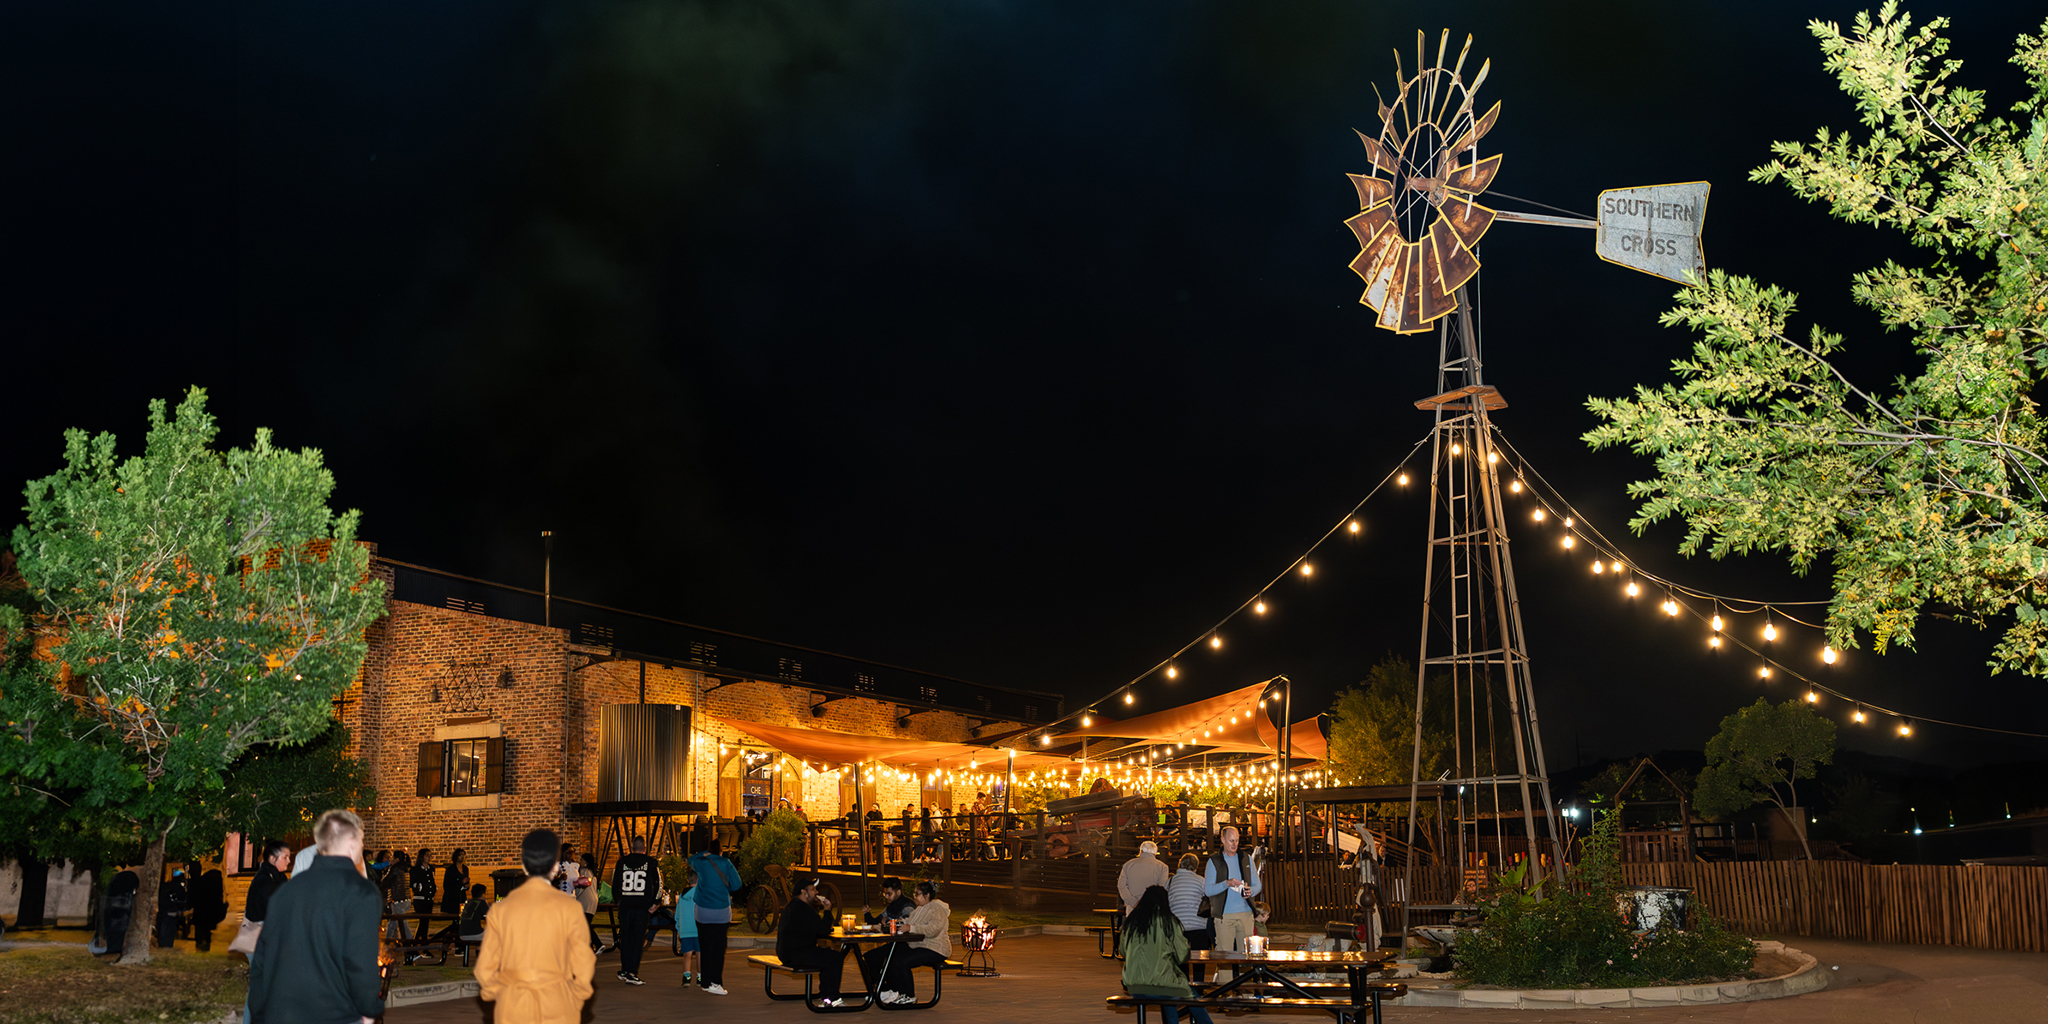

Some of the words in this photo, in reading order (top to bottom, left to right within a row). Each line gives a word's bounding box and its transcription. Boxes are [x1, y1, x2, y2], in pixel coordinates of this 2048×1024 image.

[1605, 198, 1694, 222] SOUTHERN
[1621, 235, 1676, 256] CROSS
[622, 870, 646, 891] 86
